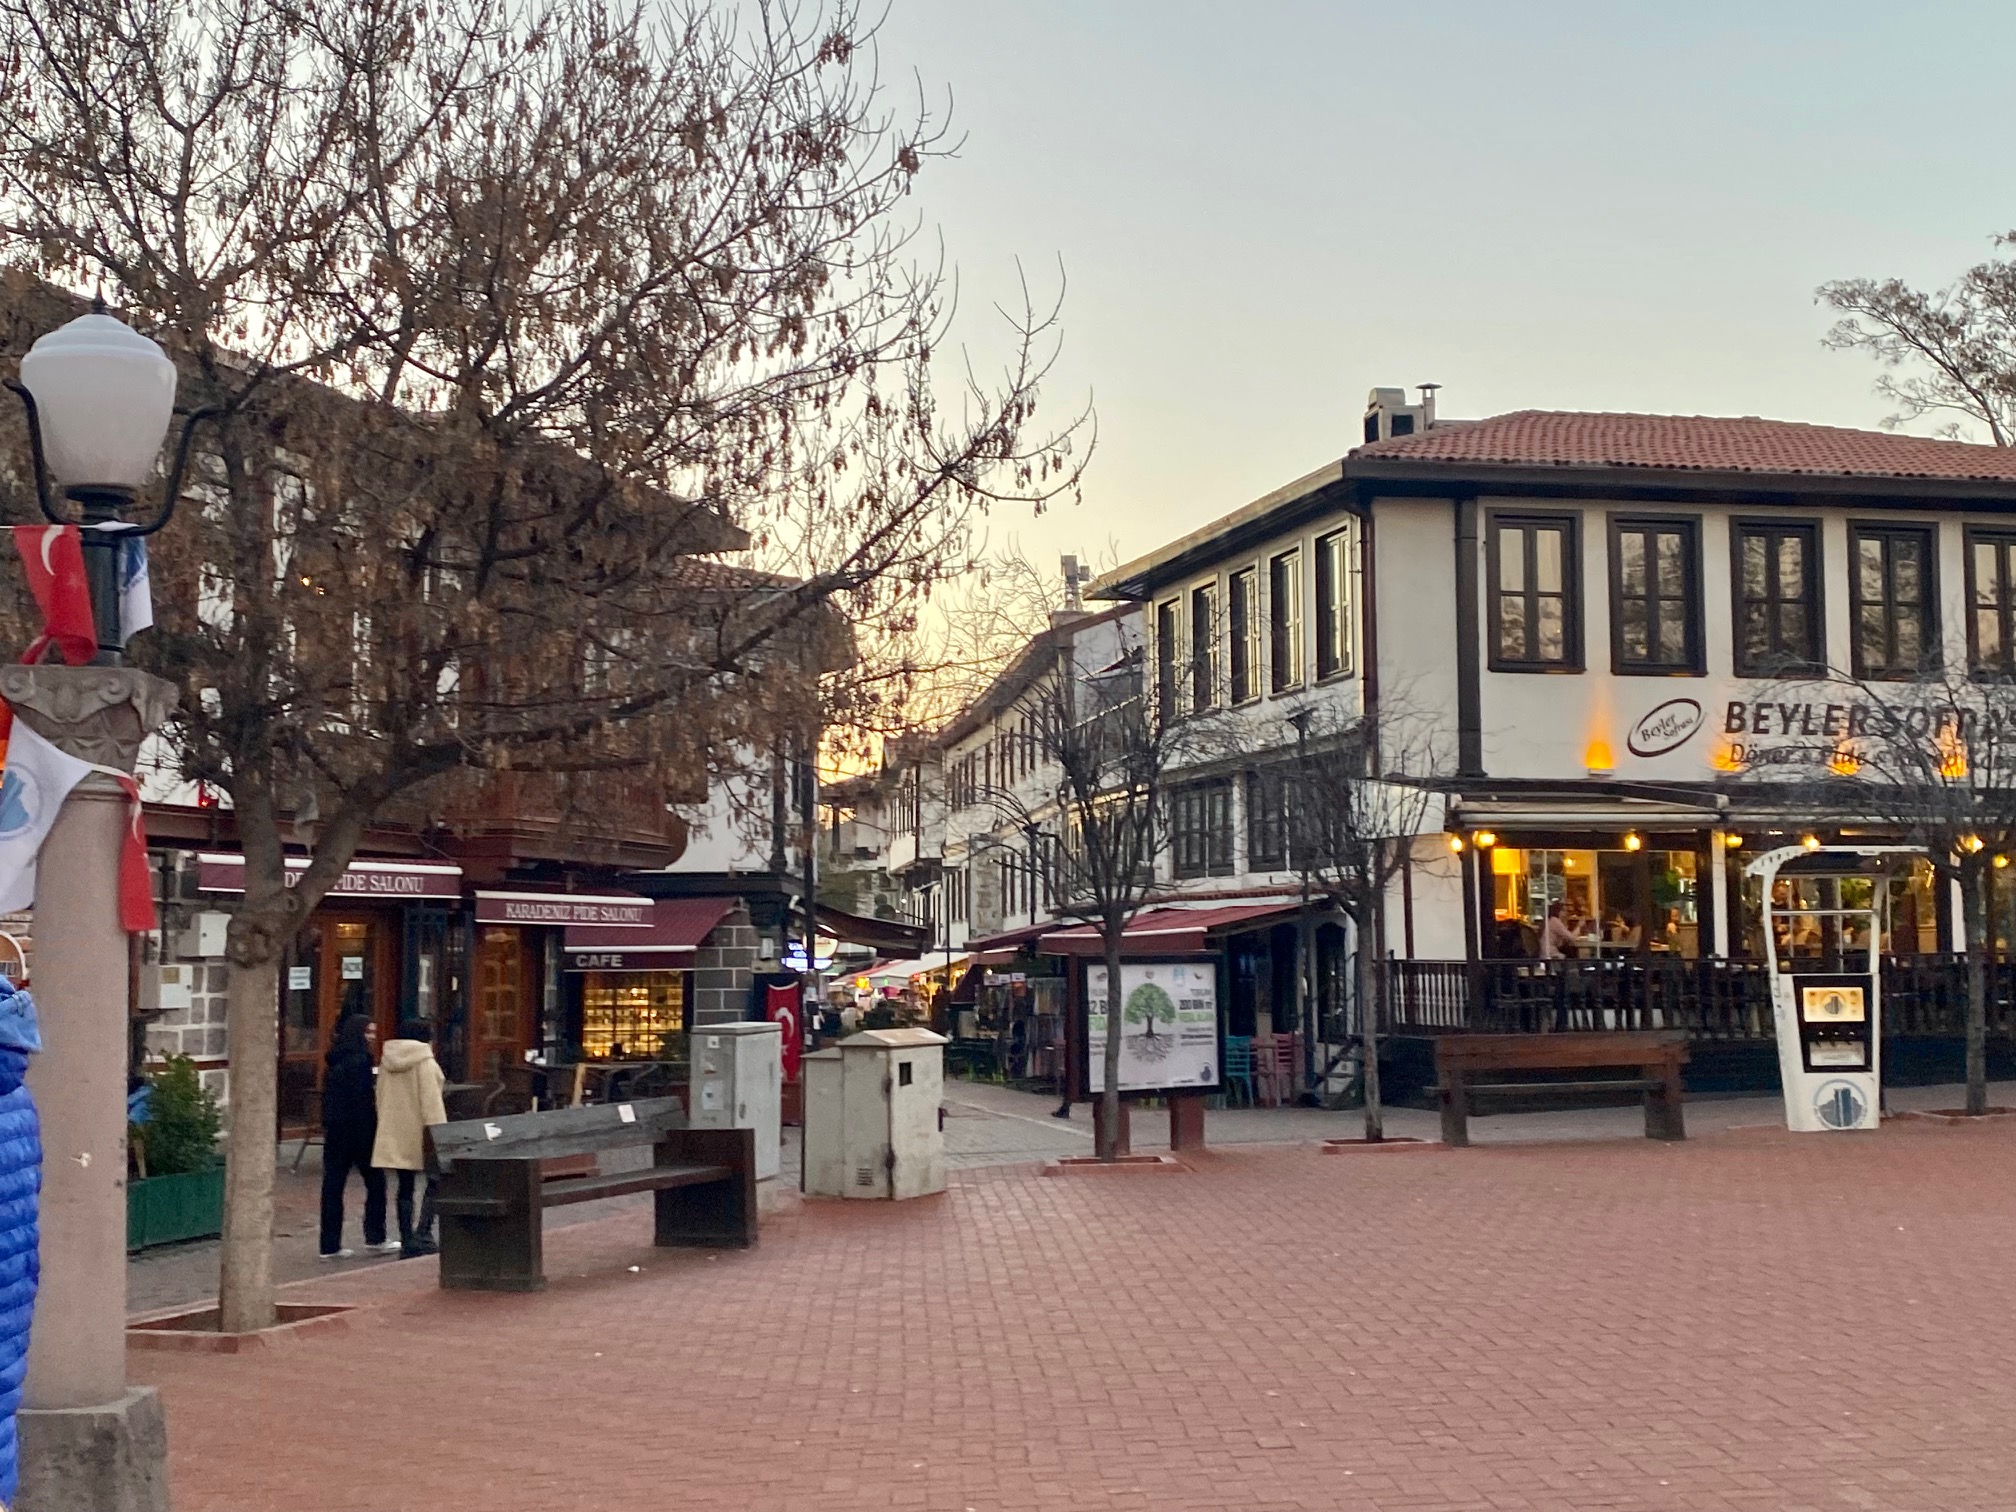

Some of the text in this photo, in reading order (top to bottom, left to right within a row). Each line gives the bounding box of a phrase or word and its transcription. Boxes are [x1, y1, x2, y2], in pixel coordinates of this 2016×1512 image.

[1641, 713, 1676, 742] Beyler
[1725, 701, 1871, 737] BEYLER
[369, 875, 424, 893] SALONU
[600, 906, 643, 922] SALONU
[576, 954, 623, 968] CAFE
